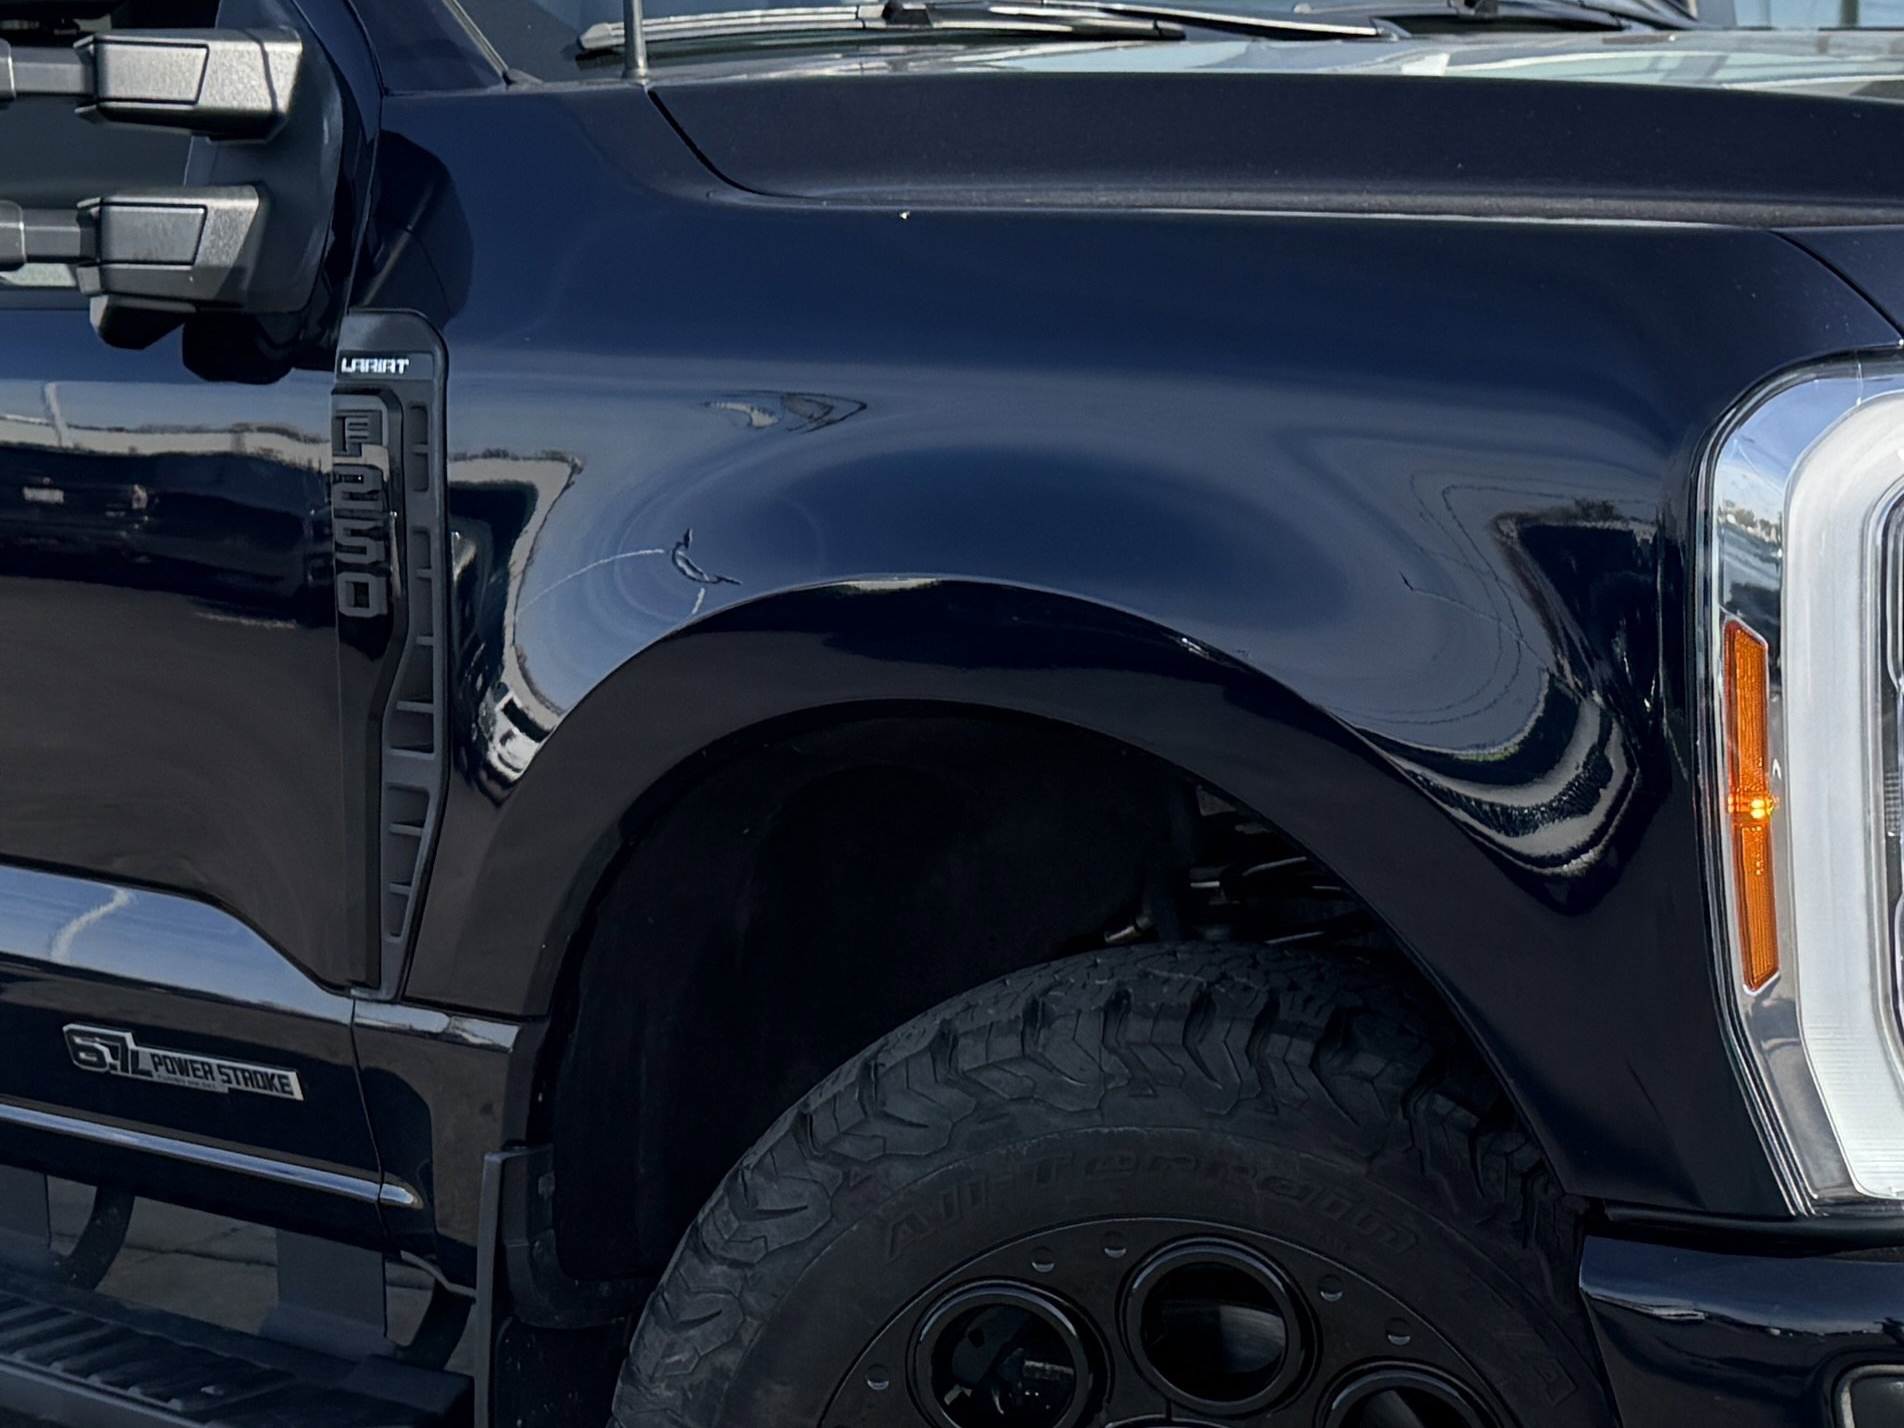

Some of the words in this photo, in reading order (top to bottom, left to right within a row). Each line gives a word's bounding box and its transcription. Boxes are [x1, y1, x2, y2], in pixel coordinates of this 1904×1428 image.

[340, 356, 410, 376] LARIAT
[149, 1052, 216, 1082] POWER
[216, 1065, 294, 1096] STROKE
